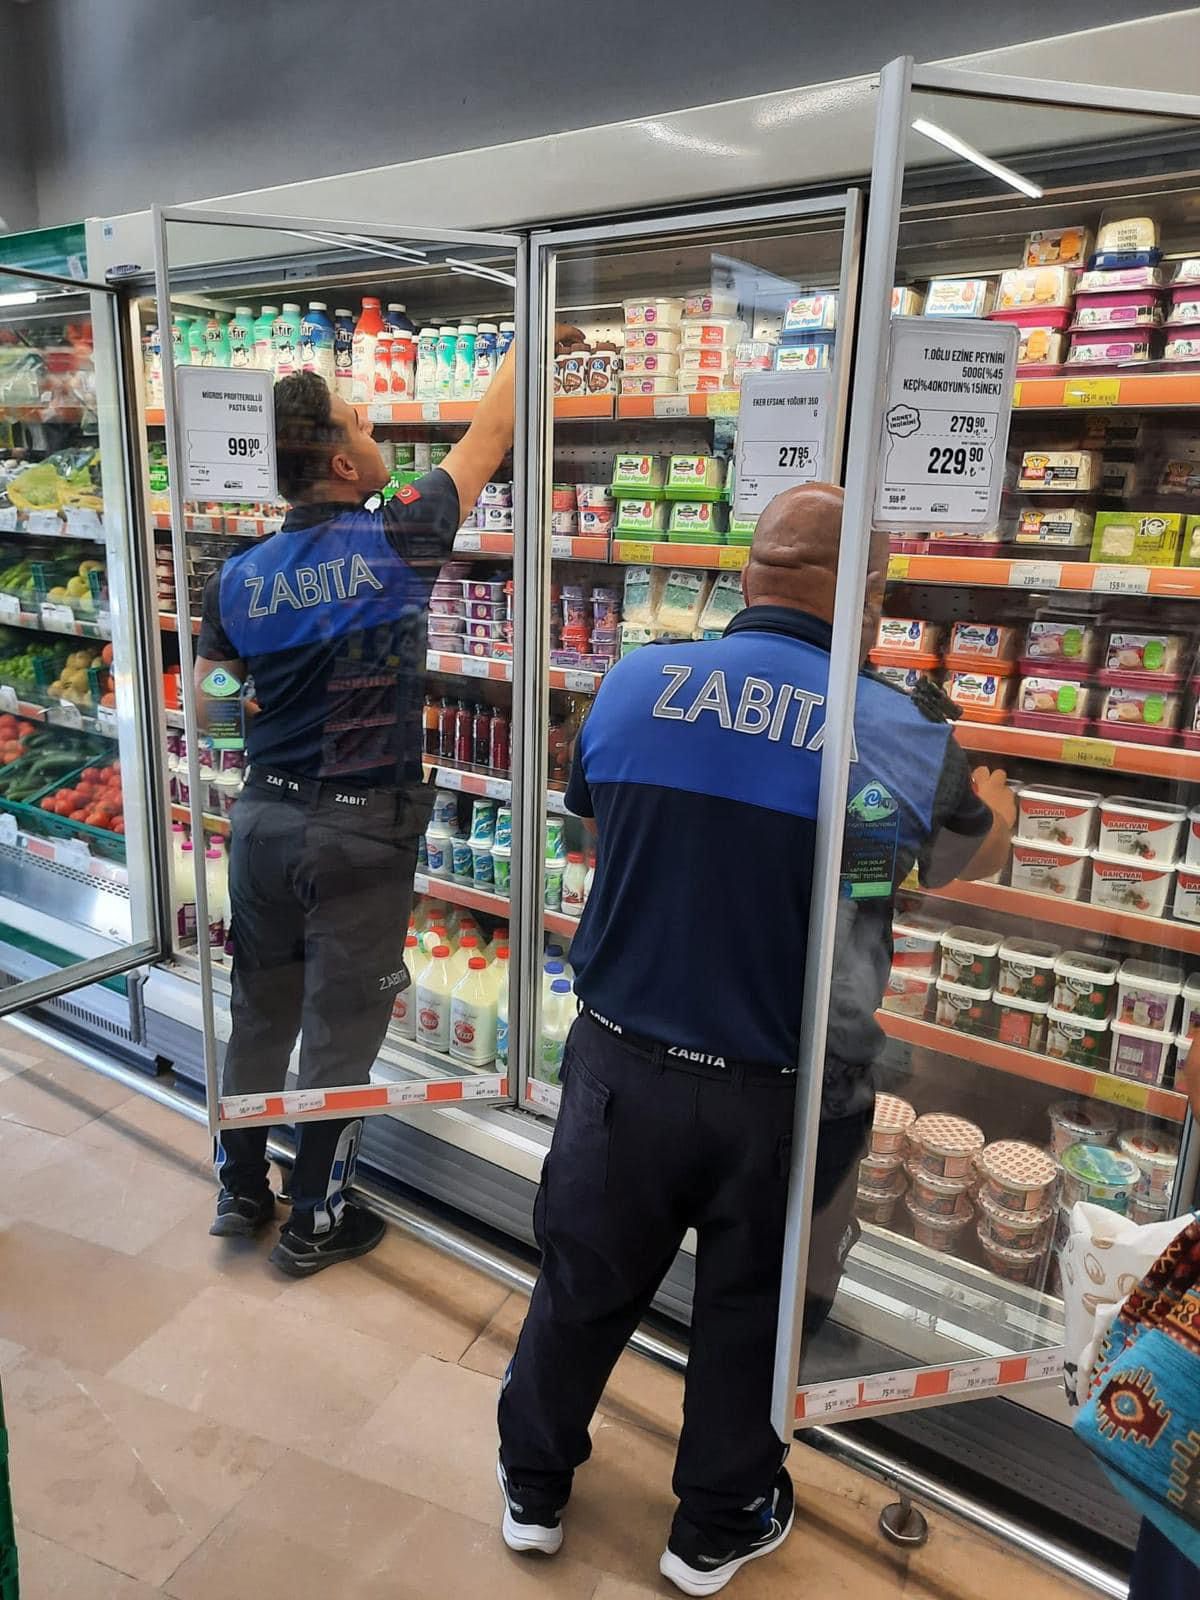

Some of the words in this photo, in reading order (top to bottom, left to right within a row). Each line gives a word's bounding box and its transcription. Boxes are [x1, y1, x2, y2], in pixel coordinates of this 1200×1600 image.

[924, 348, 951, 362] T.OĞLU
[951, 349, 974, 363] EZİNE
[228, 403, 246, 412] PASTA
[753, 398, 766, 407] EKER
[766, 398, 786, 406] EFSANE
[787, 396, 807, 406] YOĞURT
[807, 397, 819, 406] 350
[813, 409, 818, 417] G
[891, 413, 912, 422] MONEY
[244, 553, 384, 618] ZABITA
[335, 793, 368, 806] ZABIT
[667, 1046, 726, 1068] ZABITA
